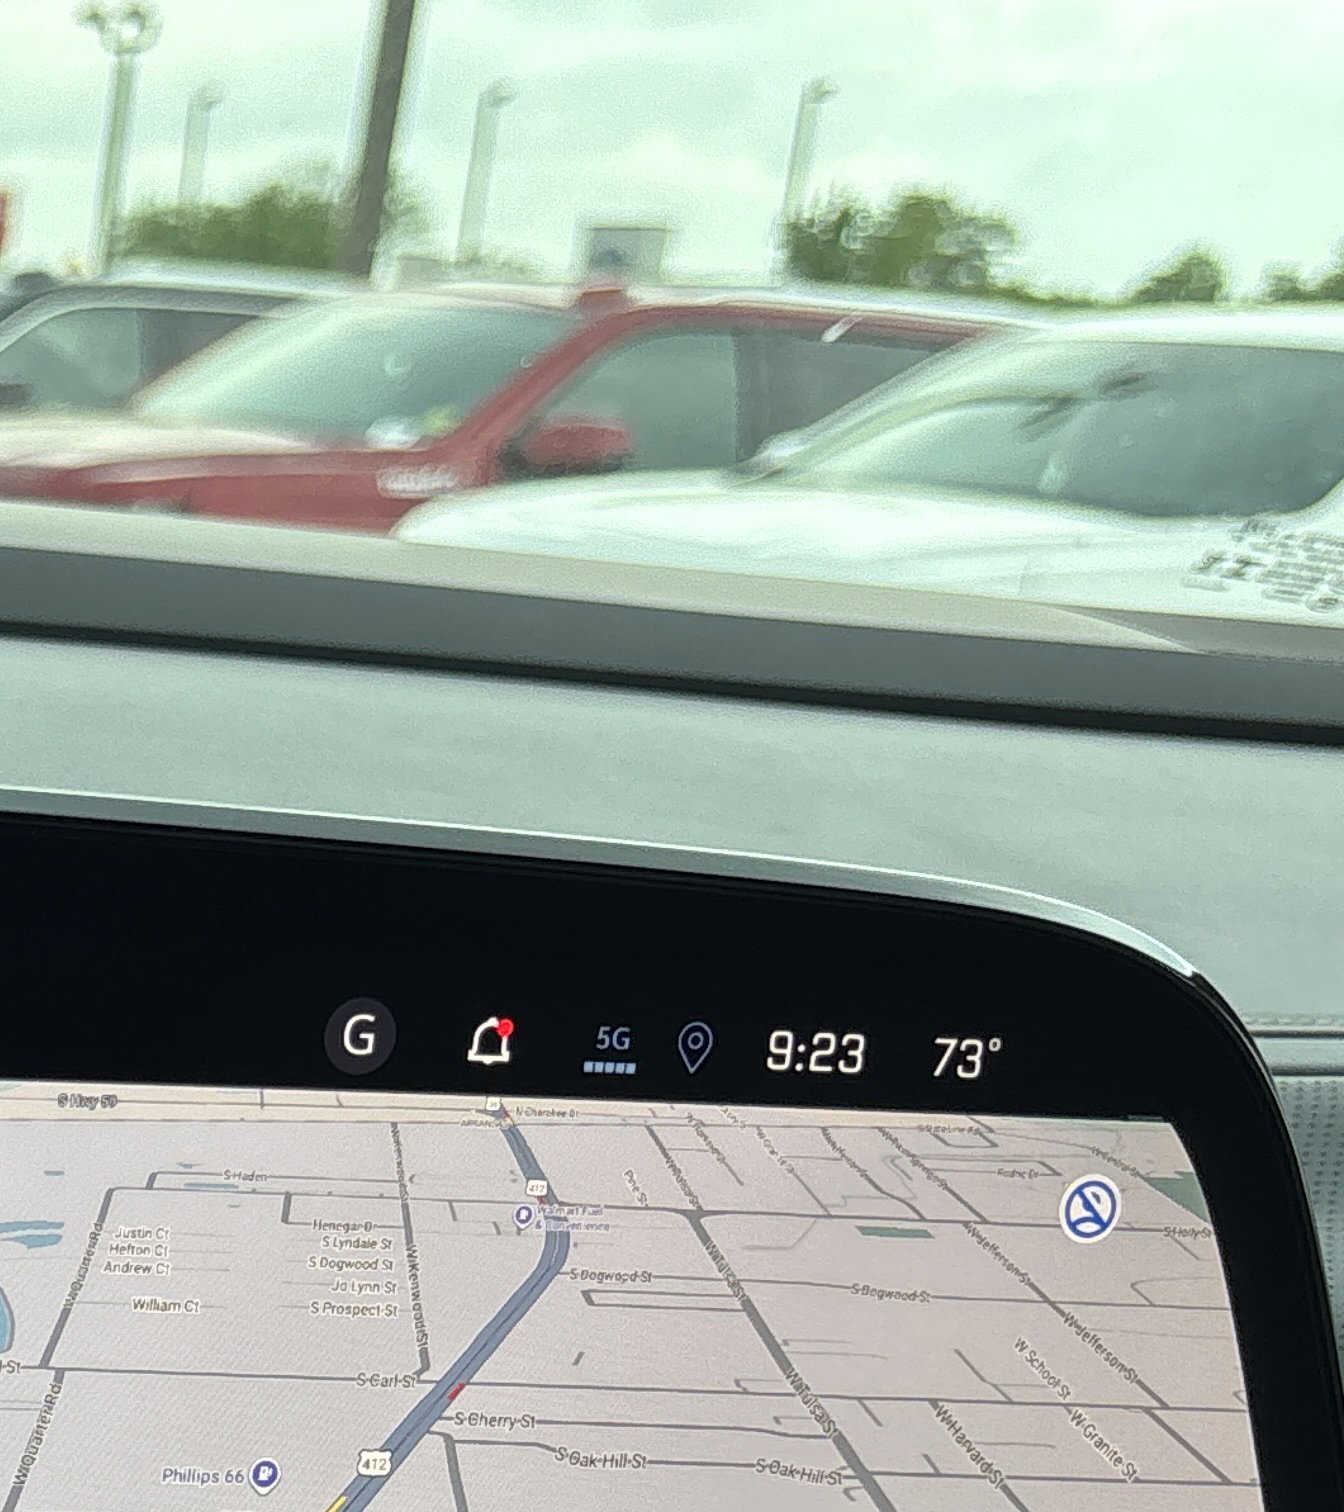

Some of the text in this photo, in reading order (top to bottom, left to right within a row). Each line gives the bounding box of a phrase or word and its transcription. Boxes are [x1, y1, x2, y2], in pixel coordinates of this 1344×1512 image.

[344, 1015, 376, 1055] G
[597, 1027, 630, 1051] 5G
[767, 1030, 865, 1074] 9:23
[933, 1037, 1001, 1079] 73°
[115, 1227, 152, 1239] Justin
[322, 1236, 330, 1249] S
[332, 1237, 377, 1252] Lyndale
[104, 1261, 170, 1275] Andrew Ct
[308, 1257, 393, 1273] S Dogwood St
[570, 1269, 578, 1281] S
[639, 1270, 652, 1283] St
[332, 1279, 397, 1296] Jo Lynn St
[132, 1299, 200, 1314] William Ct
[310, 1301, 397, 1319] S Prospect St
[1014, 1337, 1072, 1401] W School St
[934, 1404, 1006, 1489] W Harvard St
[1069, 1408, 1138, 1482] W Granite St
[361, 1457, 387, 1471] 412
[162, 1468, 244, 1486] Phillips 66
